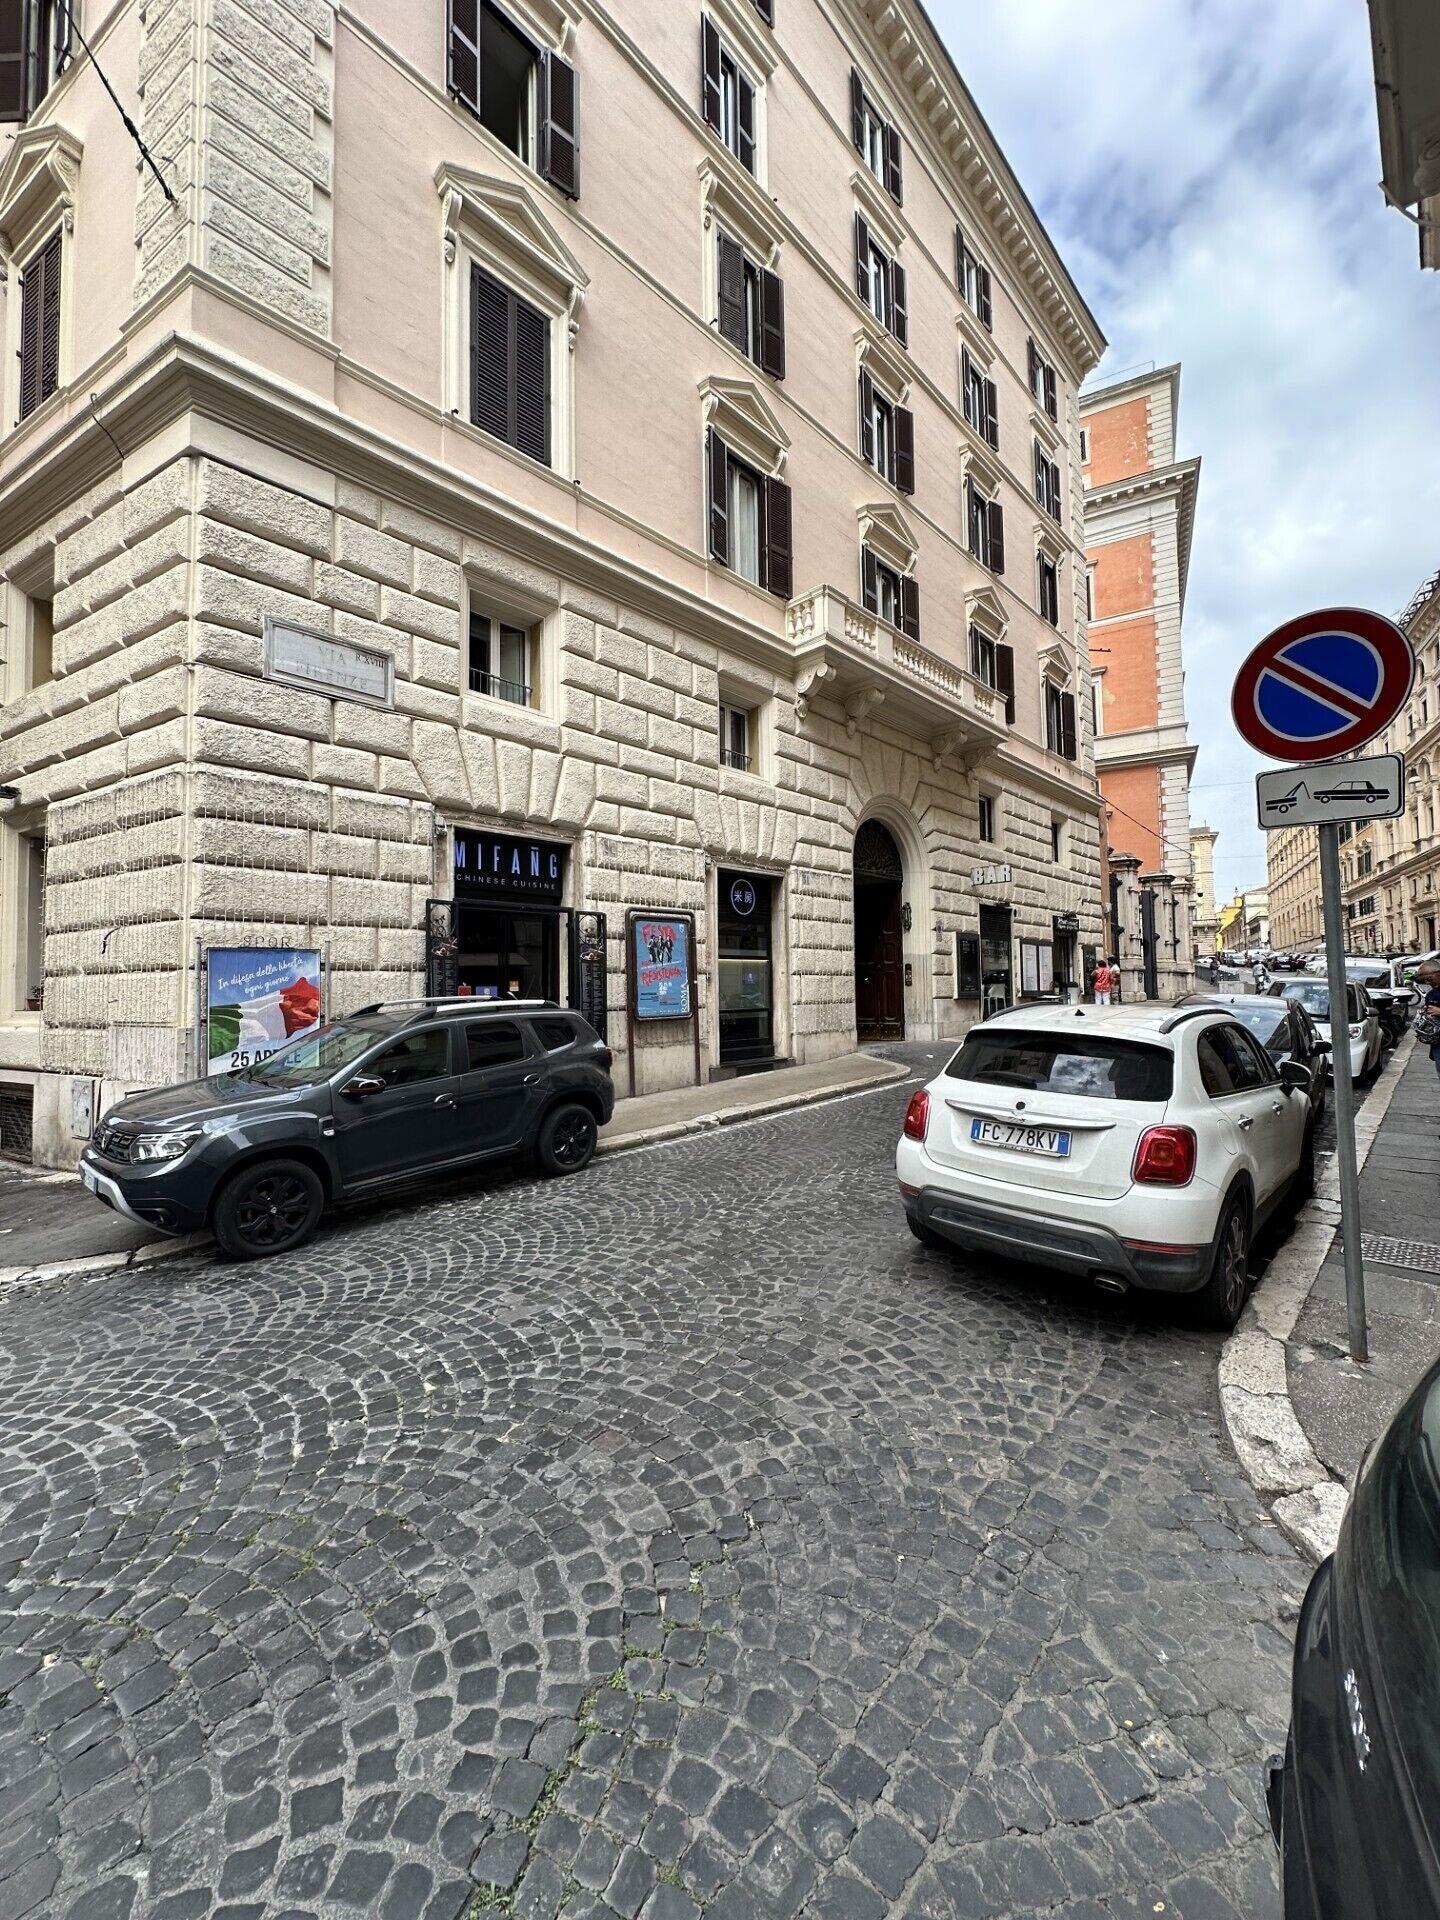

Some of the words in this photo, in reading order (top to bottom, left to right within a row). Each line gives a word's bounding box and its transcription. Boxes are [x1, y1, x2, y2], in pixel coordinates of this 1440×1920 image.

[319, 645, 346, 665] VIA
[296, 660, 368, 689] FIRENZE
[456, 874, 506, 886] CHINESE
[512, 880, 556, 890] CUISINE
[971, 864, 1012, 886] BAR
[218, 979, 230, 990] In
[230, 972, 255, 986] difesa
[256, 964, 278, 978] della
[244, 984, 264, 998] ogni
[680, 974, 690, 1013] ROMA
[231, 1051, 249, 1068] 25
[982, 1123, 1000, 1141] FC
[1005, 1126, 1057, 1150] 778KV
